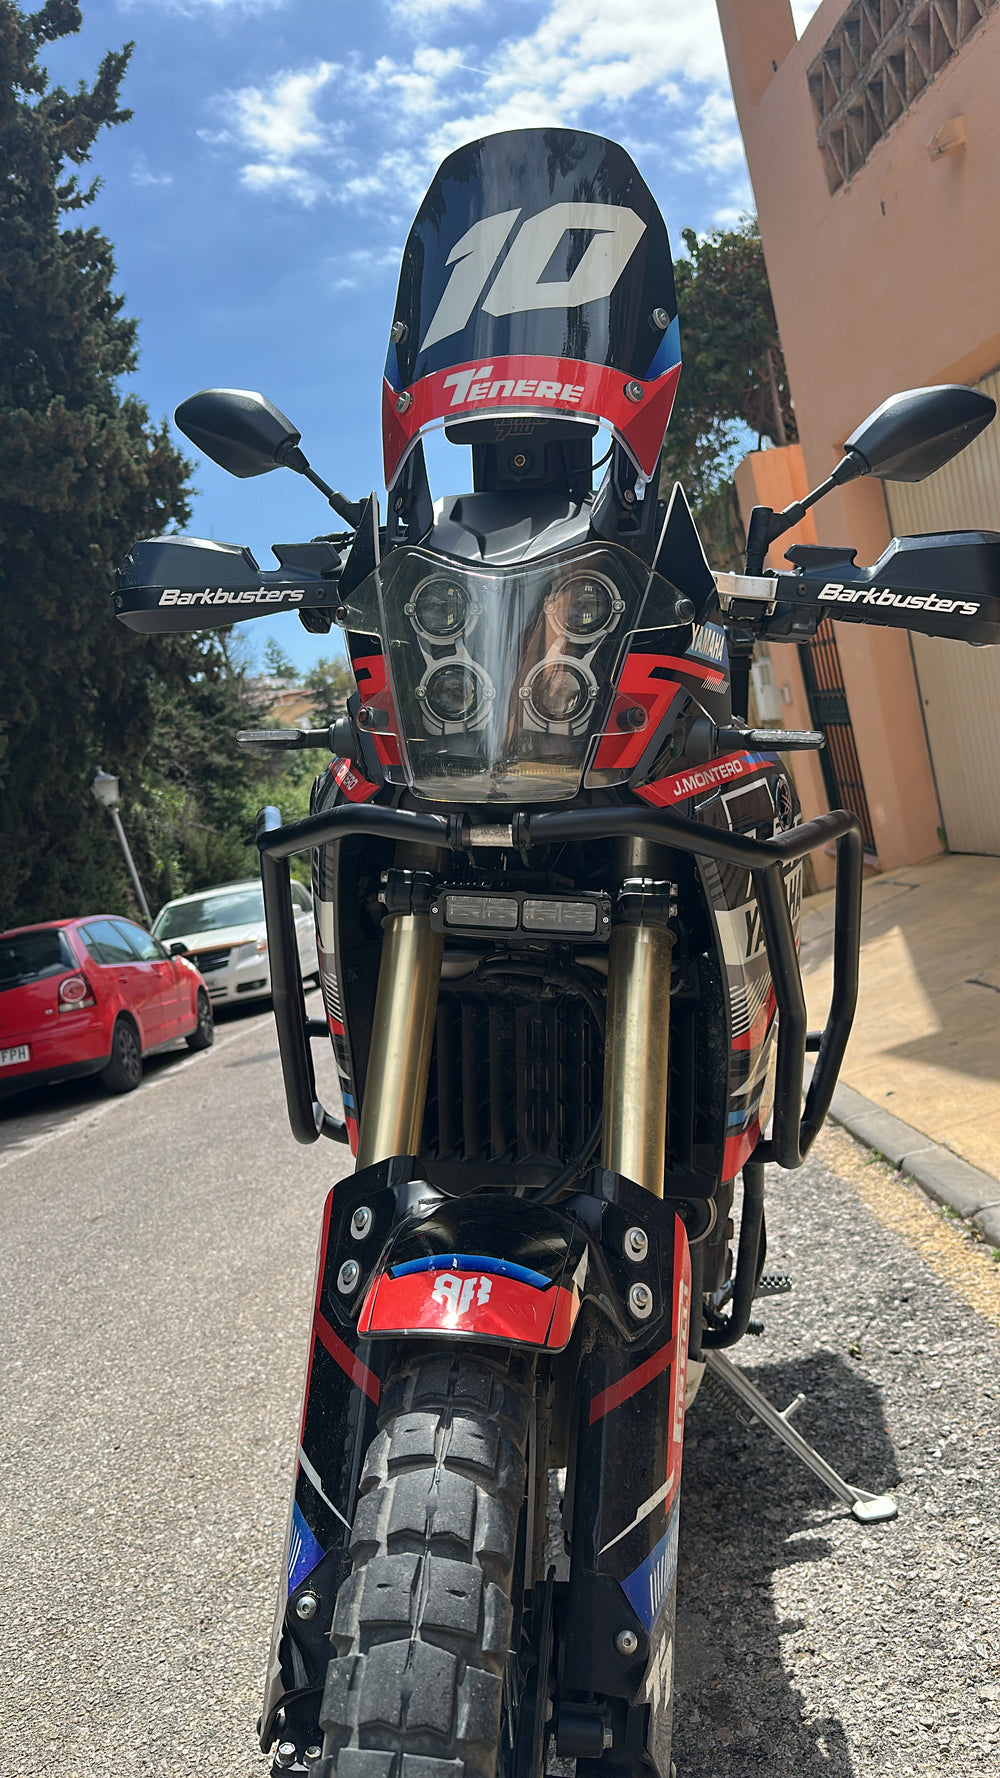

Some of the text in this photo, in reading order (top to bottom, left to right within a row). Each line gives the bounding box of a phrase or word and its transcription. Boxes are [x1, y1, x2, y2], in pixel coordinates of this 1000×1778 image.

[420, 202, 647, 353] 10
[158, 586, 306, 606] Barkbusters
[817, 583, 980, 615] Barkbusters
[691, 622, 724, 661] YAMAHA
[673, 759, 743, 796] J.MONTERO
[2, 1047, 26, 1064] FPH
